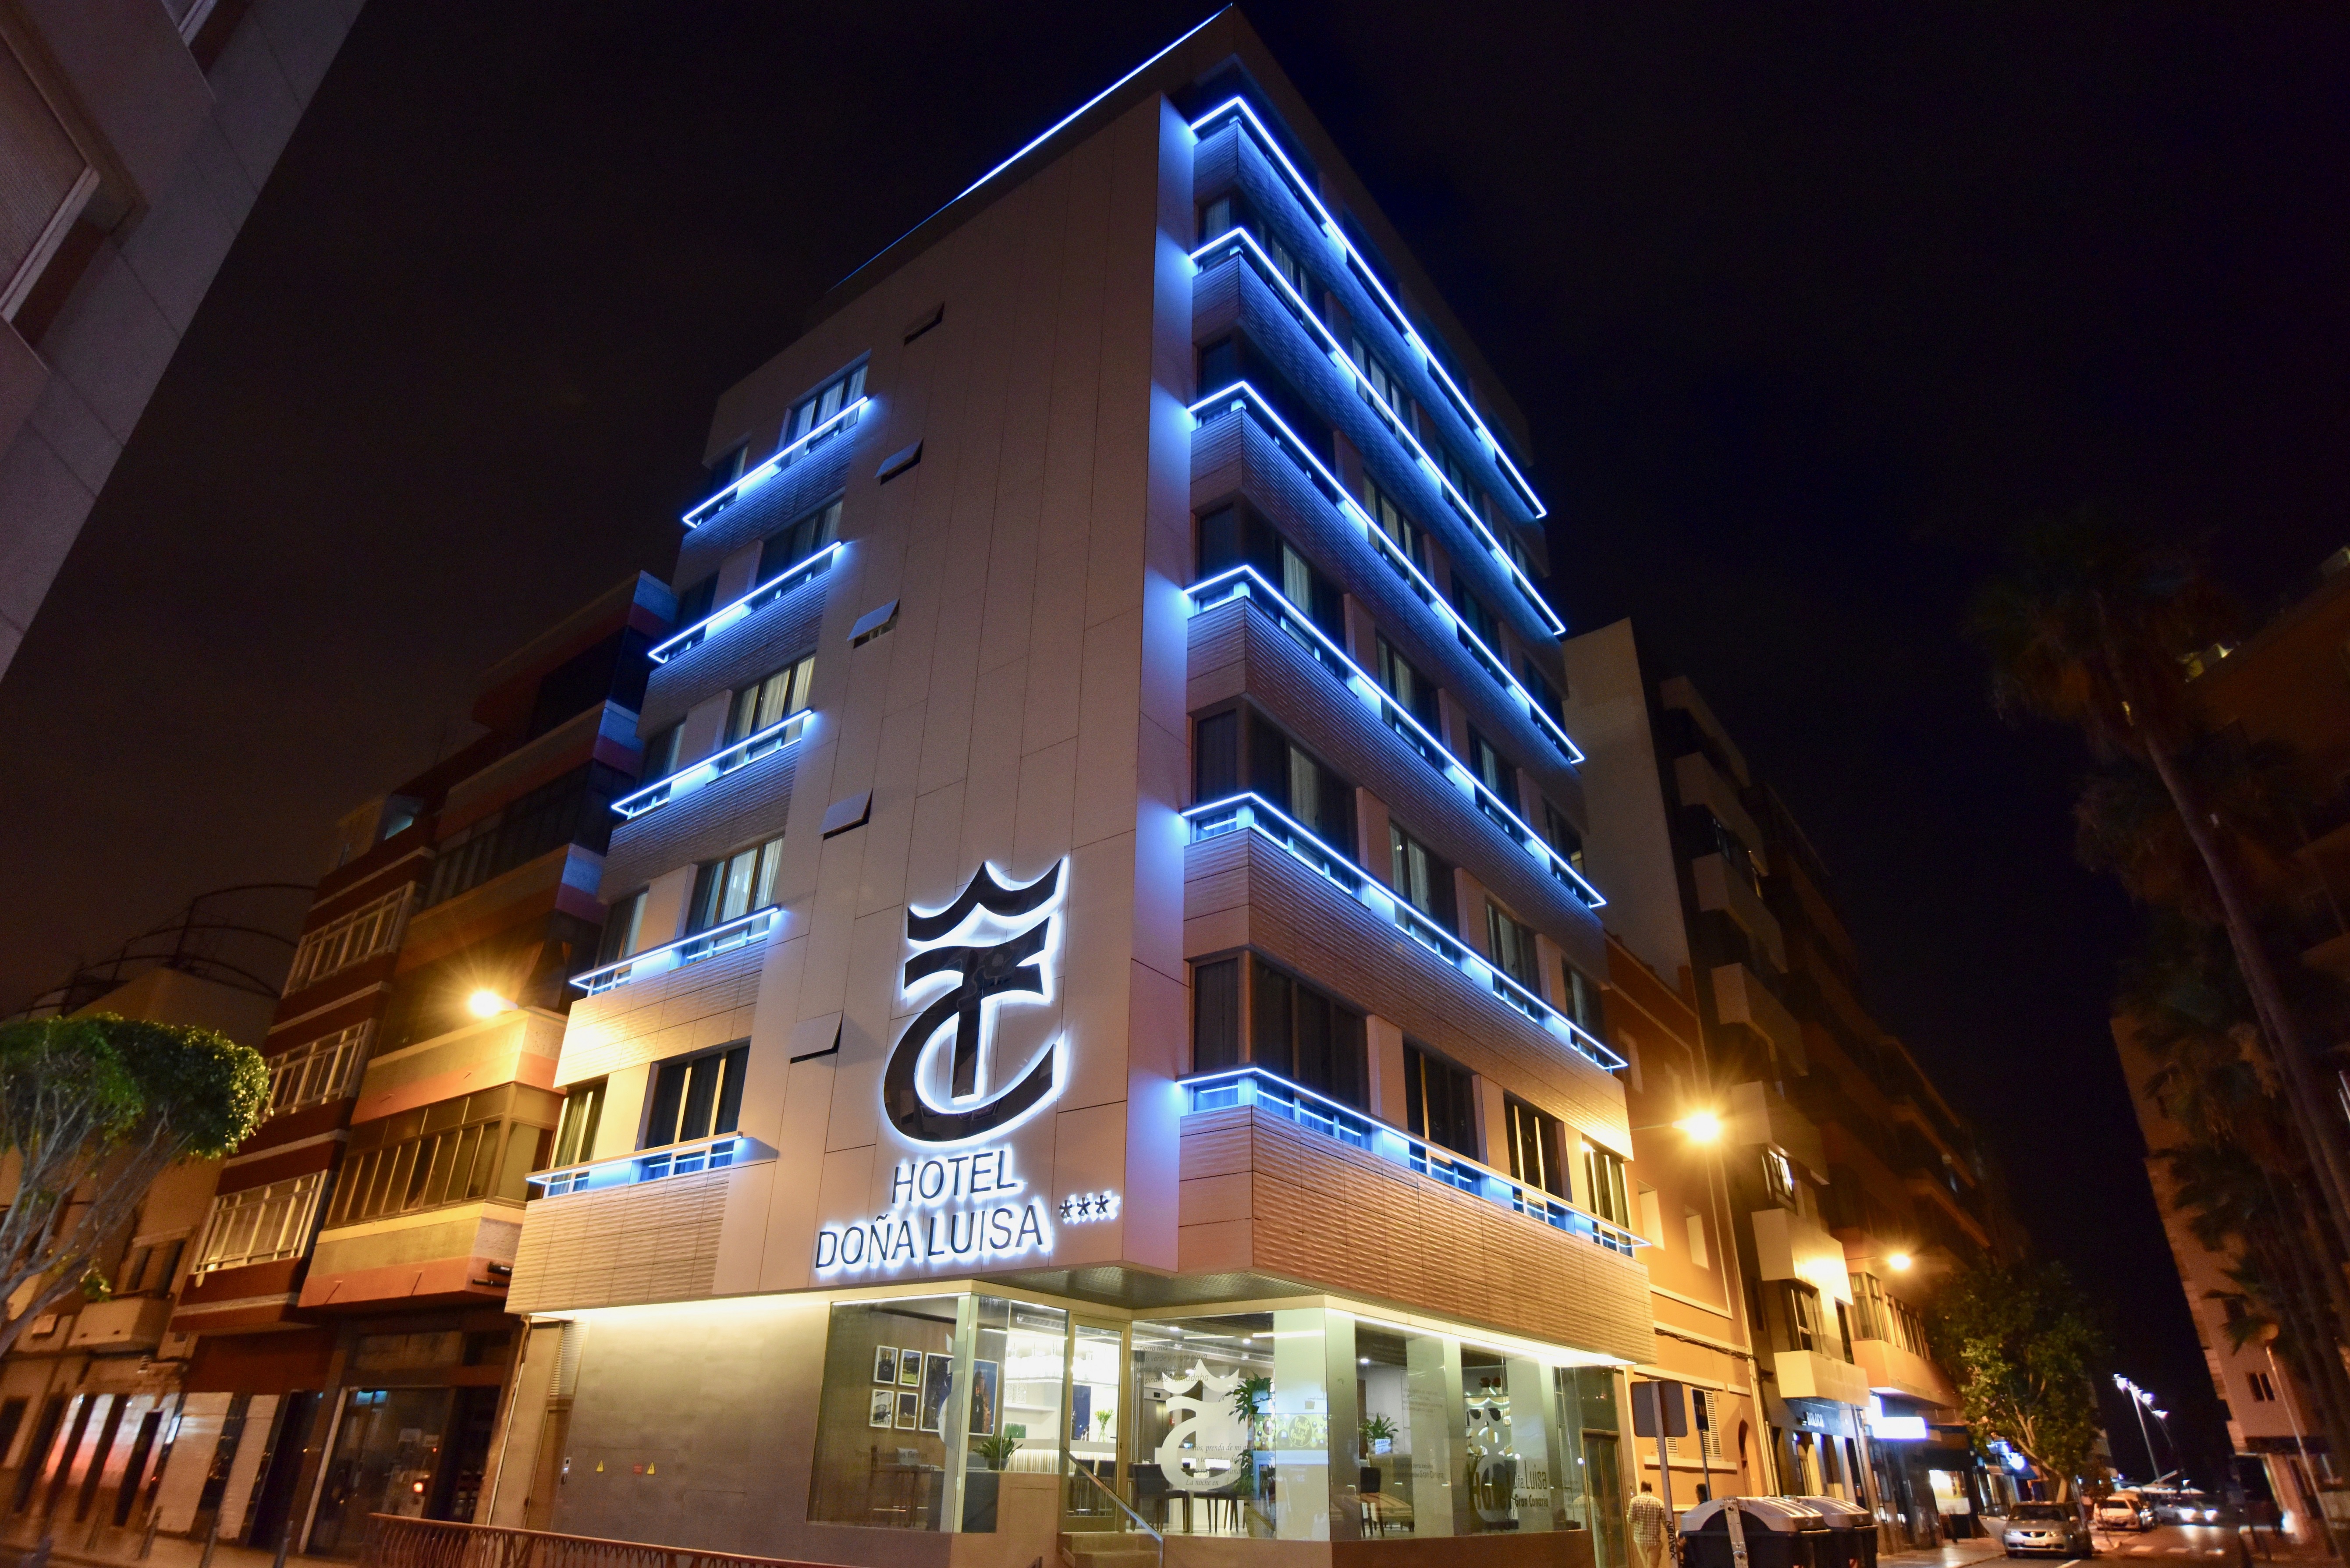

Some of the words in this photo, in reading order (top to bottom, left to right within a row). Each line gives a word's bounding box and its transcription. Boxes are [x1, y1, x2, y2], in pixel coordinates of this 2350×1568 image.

[892, 1149, 1017, 1204] HOTEL
[816, 1214, 914, 1269] DOÑA
[928, 1204, 1044, 1256] LUISA
[1205, 1443, 1224, 1453] prenda
[1226, 1442, 1233, 1451] de
[1524, 1460, 1548, 1490] Luisa
[1515, 1494, 1528, 1507] Gran
[1529, 1494, 1549, 1507] Canaria
